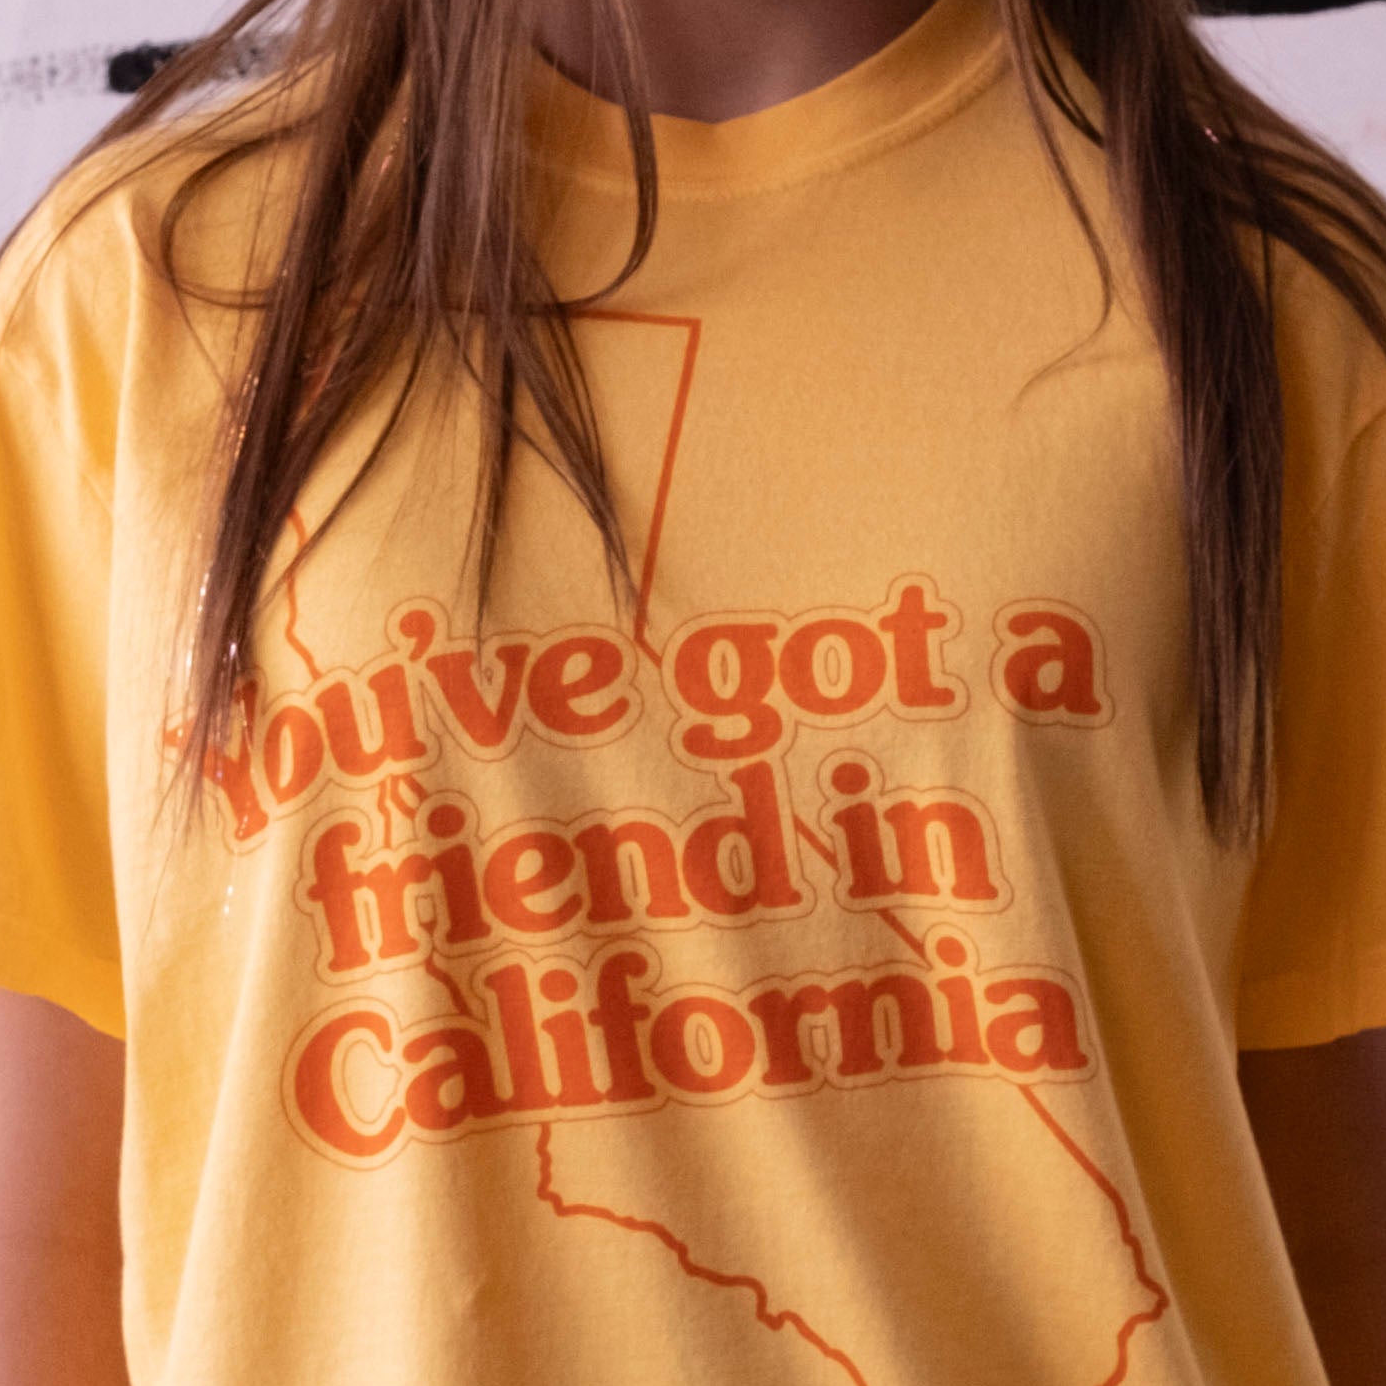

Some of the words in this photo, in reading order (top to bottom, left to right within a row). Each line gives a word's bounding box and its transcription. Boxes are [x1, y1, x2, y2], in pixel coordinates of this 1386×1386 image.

[674, 584, 955, 760] got
[1005, 611, 1101, 716] a
[307, 760, 803, 974] friend
[832, 761, 999, 901] in
[294, 936, 1090, 1158] California
